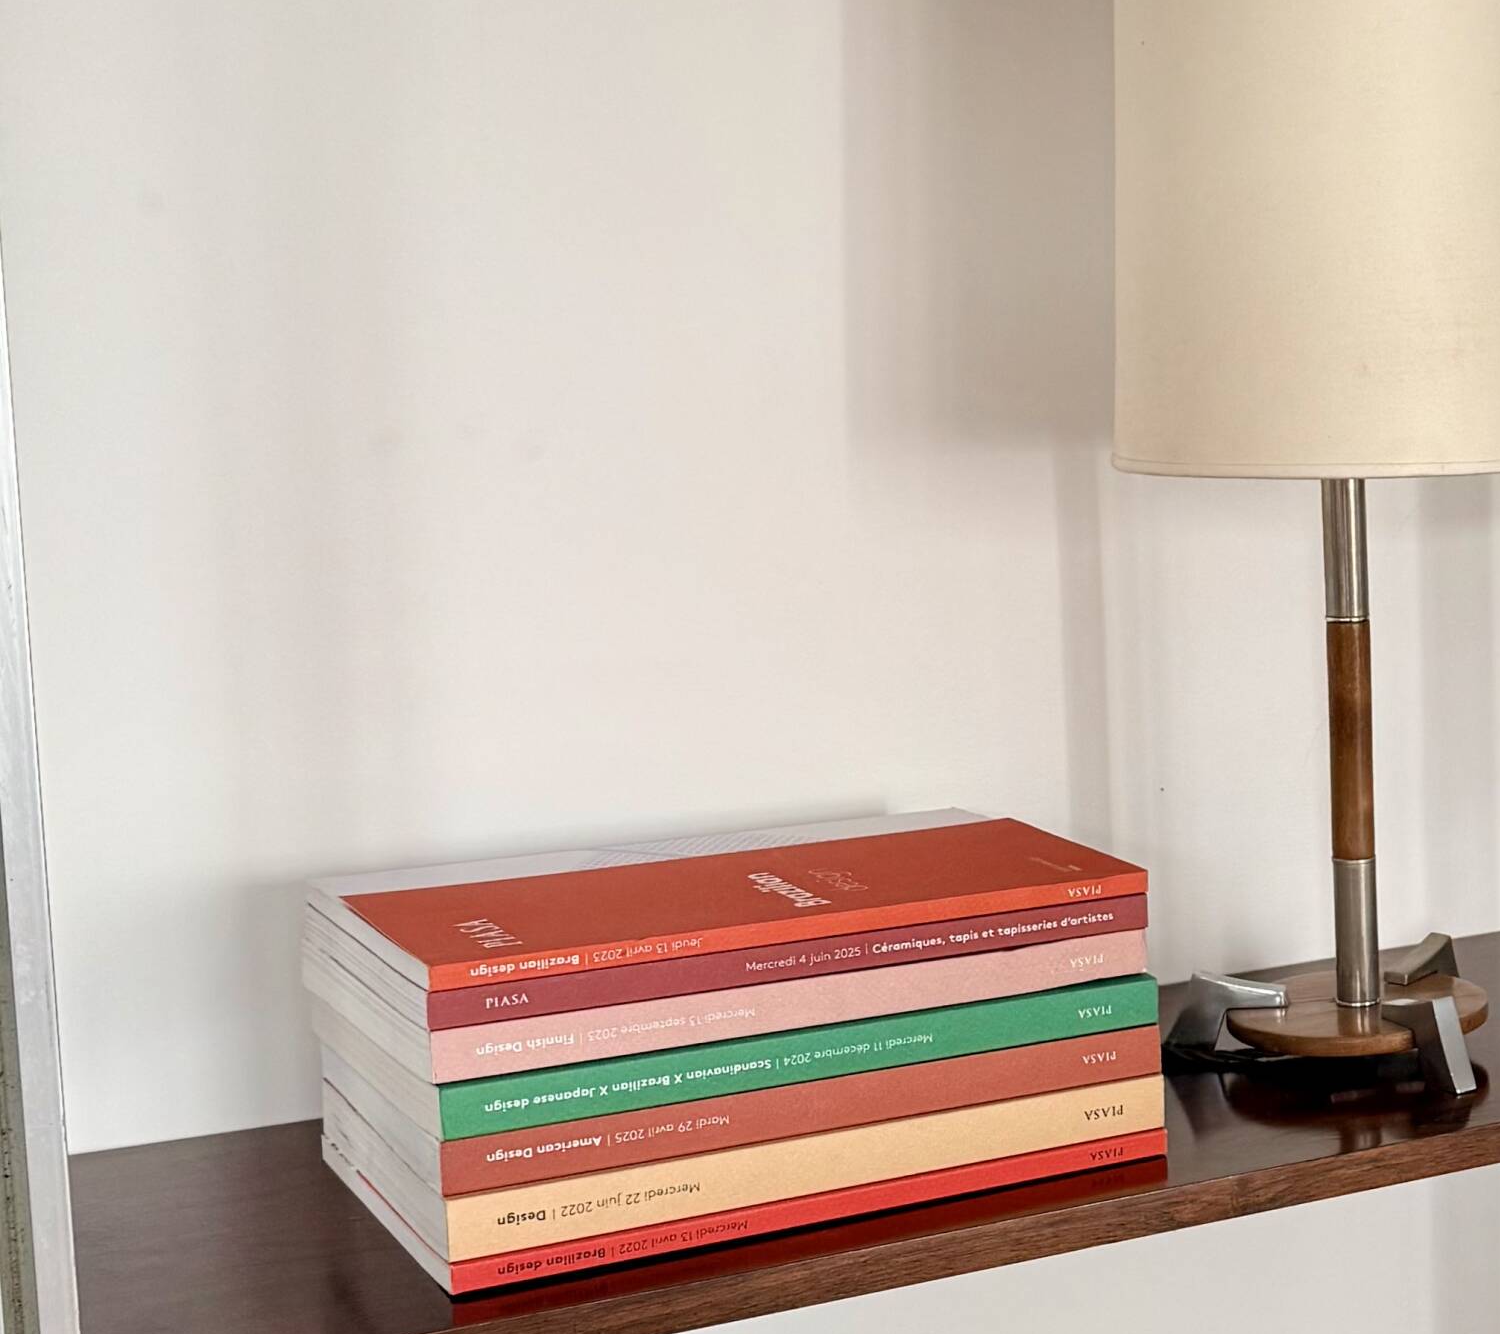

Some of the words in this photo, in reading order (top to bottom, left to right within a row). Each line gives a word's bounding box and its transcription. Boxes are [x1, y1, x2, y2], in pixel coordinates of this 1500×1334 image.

[748, 871, 831, 908] Brazilian
[1066, 883, 1102, 898] PIASA
[455, 917, 523, 949] PIASA
[625, 943, 653, 956] avril
[657, 942, 668, 954] 13
[671, 937, 703, 952] Jeudi
[746, 954, 797, 972] Mercredi
[798, 954, 807, 966] 4
[809, 950, 833, 967] juin
[834, 945, 862, 961] 2025
[871, 935, 947, 955] Céramiques,
[948, 928, 980, 945] tapis
[981, 927, 996, 939] et
[997, 919, 1059, 938] tapisseries
[1060, 911, 1115, 928] d'artistes
[518, 953, 580, 971] Brazilian
[592, 947, 624, 962] 2023
[1070, 953, 1105, 968] PIASA
[470, 961, 515, 978] design
[485, 993, 529, 1008] PIASA
[703, 1007, 757, 1023] Mercredi
[1077, 1005, 1113, 1019] PIASA
[621, 1016, 686, 1036] septembre
[688, 1015, 703, 1027] 13
[527, 1032, 575, 1050] Finnish
[587, 1027, 618, 1043] 2023
[886, 1033, 934, 1051] Mercredi
[476, 1038, 523, 1057] Design
[814, 1041, 870, 1060] décembre
[873, 1041, 883, 1053] 11
[783, 1051, 812, 1067] 2024
[1082, 1051, 1118, 1066] PIASA
[674, 1072, 684, 1084] X
[686, 1059, 772, 1082] Scandinavian
[599, 1085, 609, 1096] X
[611, 1076, 671, 1094] Brazilian
[533, 1085, 597, 1105] Japanese
[484, 1097, 530, 1115] design
[1083, 1105, 1124, 1122] PIASA
[648, 1122, 674, 1138] avril
[677, 1120, 693, 1134] 29
[696, 1114, 731, 1130] Mardi
[614, 1128, 646, 1144] 2025
[536, 1135, 603, 1155] American
[485, 1146, 533, 1164] Design
[1089, 1147, 1124, 1161] PIASA
[625, 1191, 641, 1205] 22
[644, 1181, 701, 1202] Mercredi
[560, 1200, 593, 1217] 2022
[597, 1194, 623, 1209] juin
[496, 1208, 547, 1227] Design
[680, 1230, 693, 1243] 13
[696, 1218, 749, 1240] Mercredi
[618, 1238, 649, 1255] 2022
[651, 1233, 677, 1249] avril
[546, 1247, 607, 1267] Brazilian
[496, 1260, 543, 1276] design
